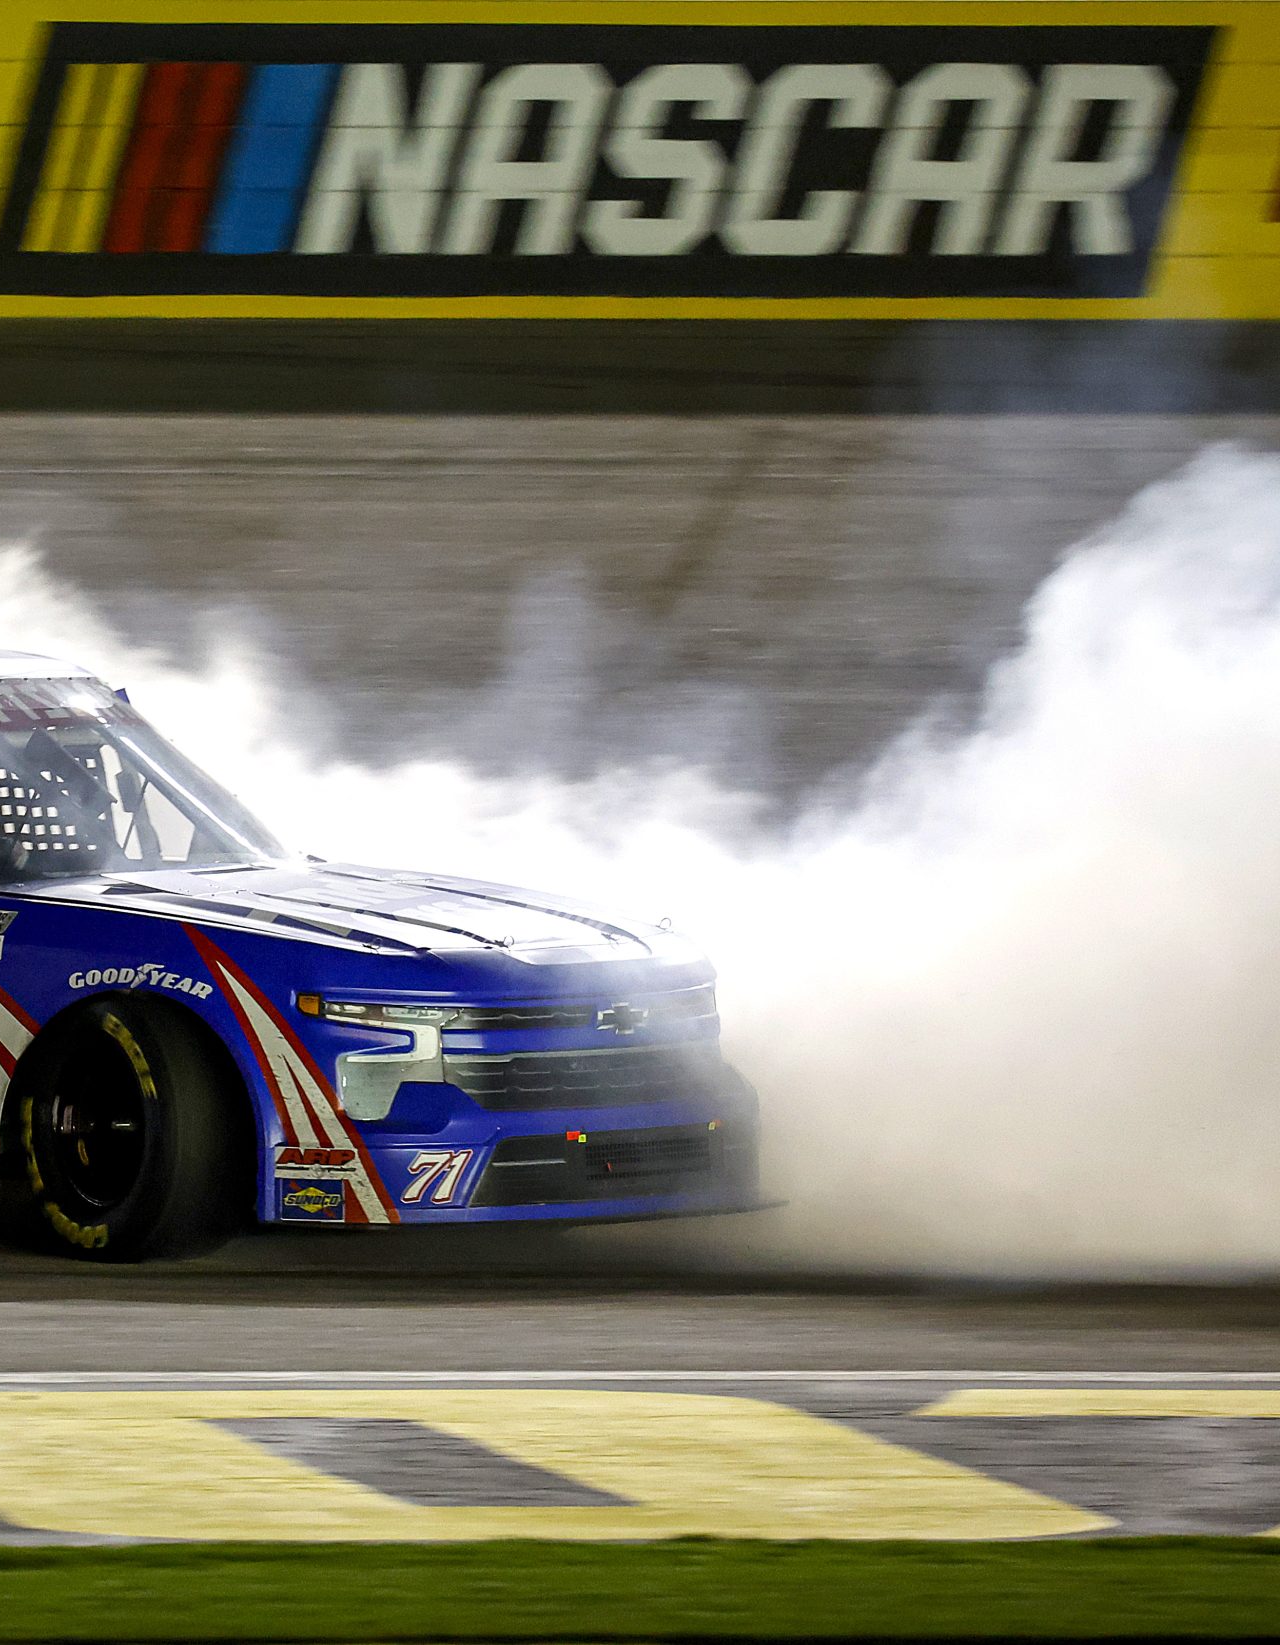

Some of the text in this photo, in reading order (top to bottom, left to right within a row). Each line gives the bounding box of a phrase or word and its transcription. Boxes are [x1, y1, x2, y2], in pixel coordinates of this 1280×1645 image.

[291, 62, 1177, 255] NASCAR
[68, 963, 213, 999] GOODYEAR
[276, 1148, 356, 1166] ARP
[401, 1149, 473, 1204] 71
[286, 1194, 340, 1206] SUNOCO
